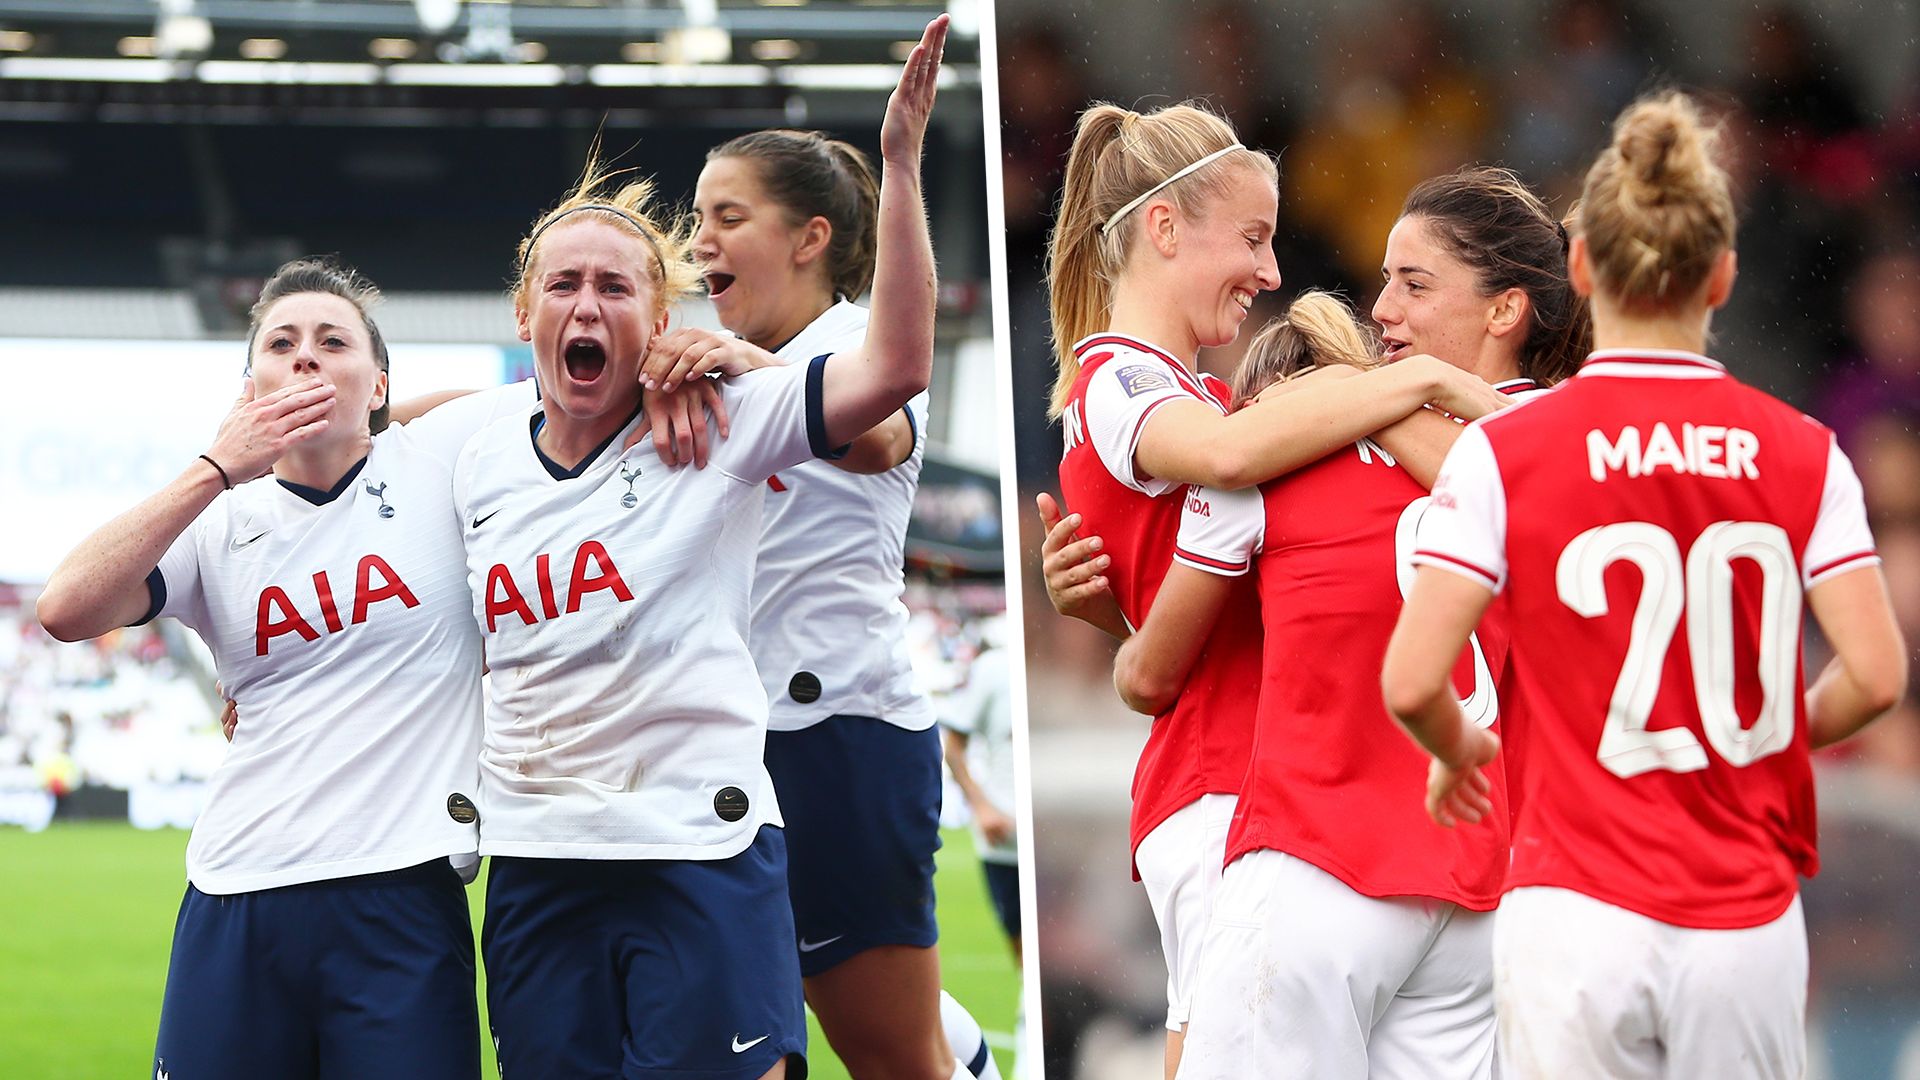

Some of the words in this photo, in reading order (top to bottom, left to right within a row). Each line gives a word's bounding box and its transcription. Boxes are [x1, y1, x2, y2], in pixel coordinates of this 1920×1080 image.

[1586, 422, 1760, 482] MAIER
[255, 554, 420, 656] AIA
[484, 540, 634, 632] AIA
[1556, 520, 1803, 778] 20
